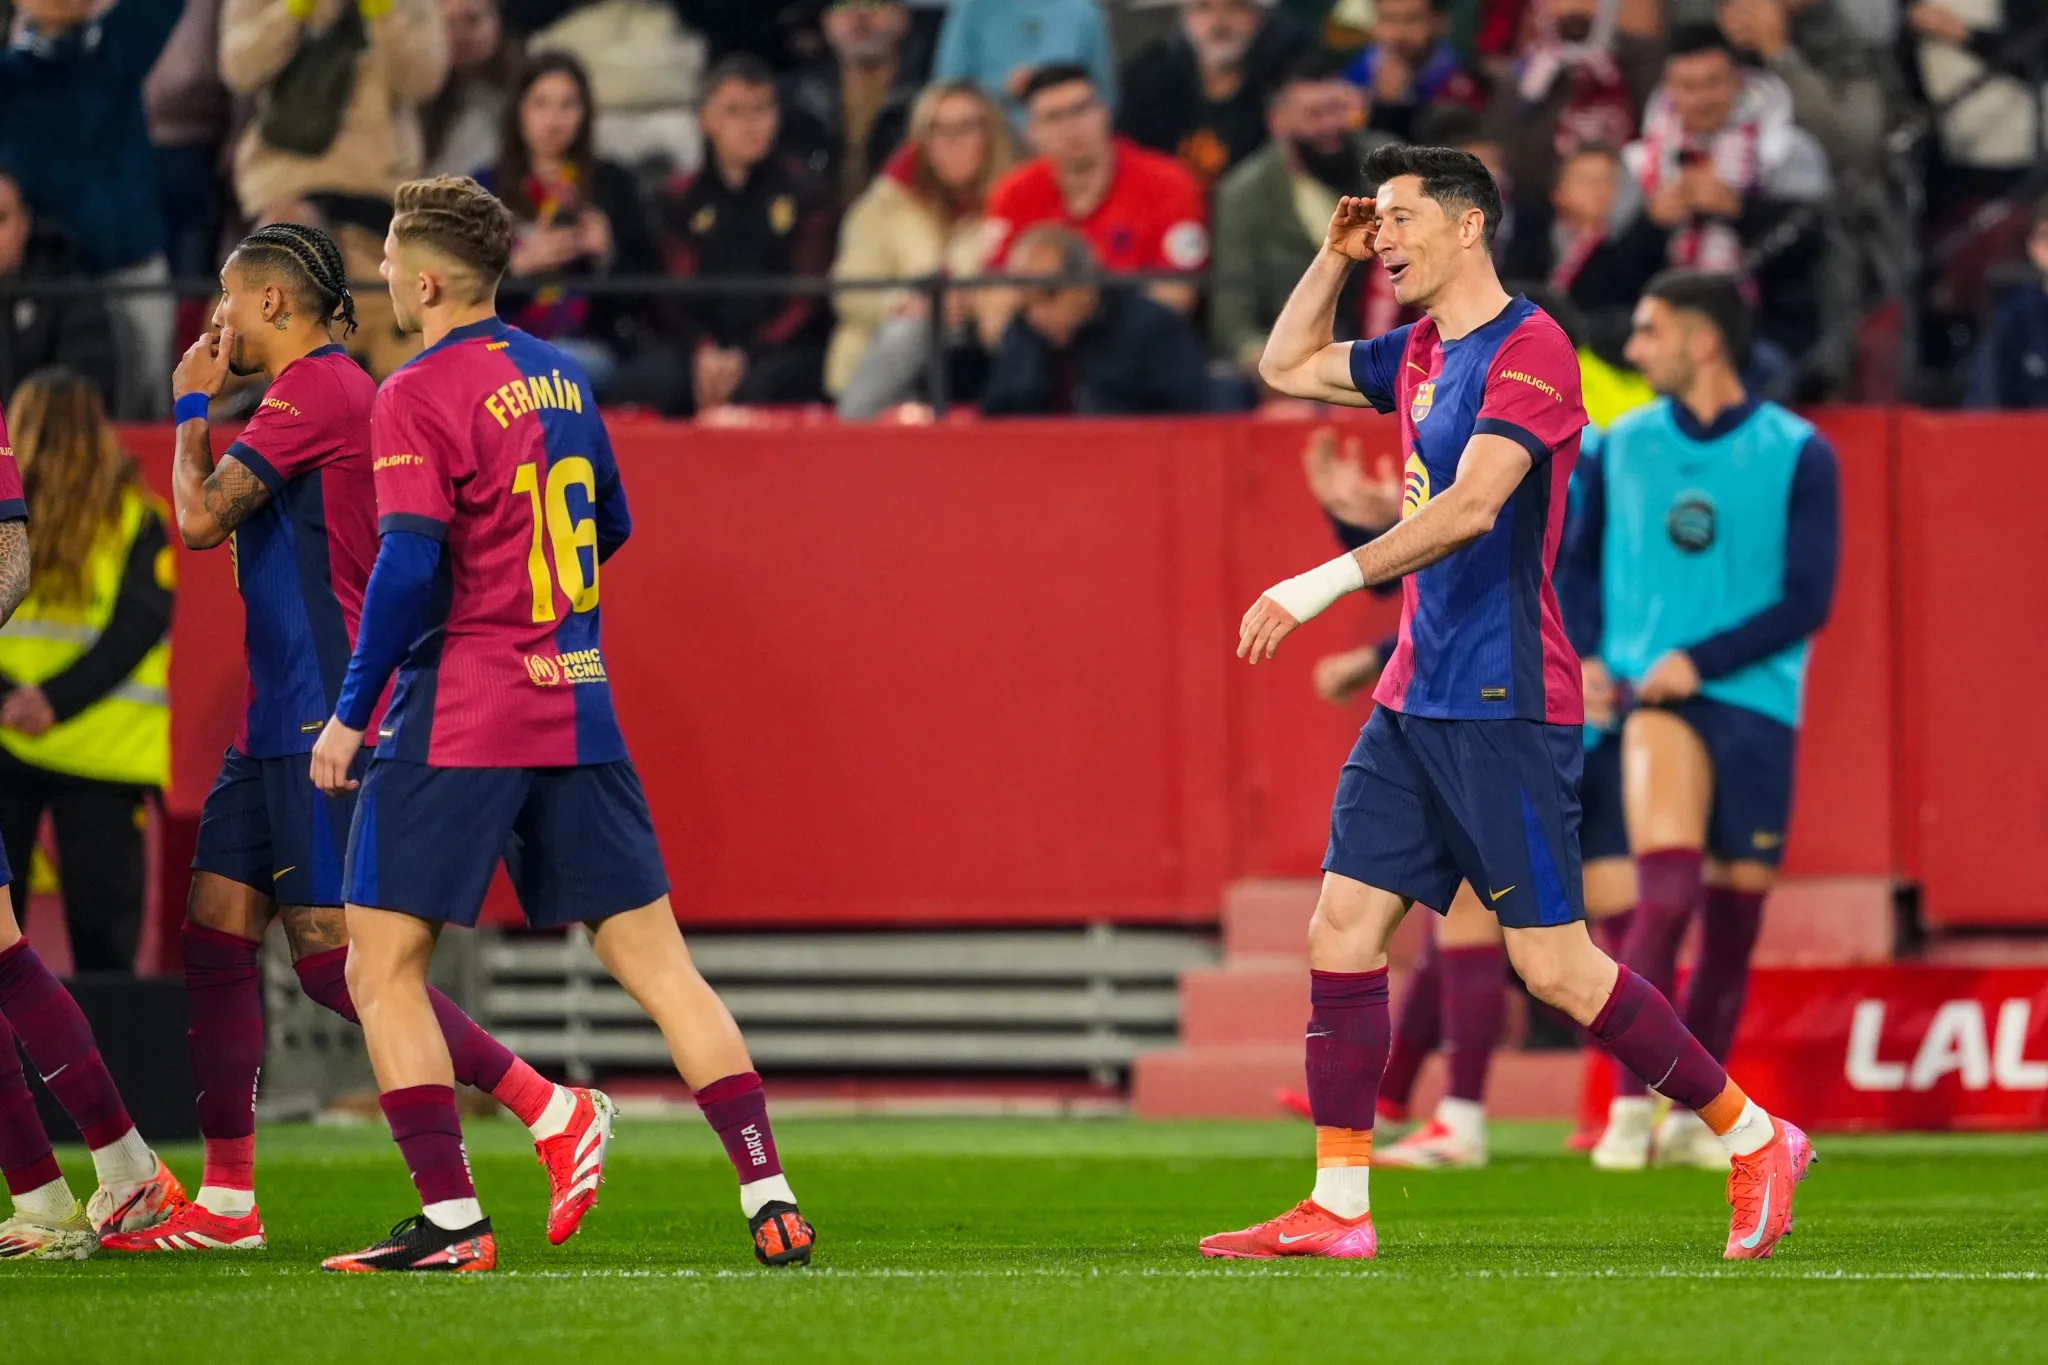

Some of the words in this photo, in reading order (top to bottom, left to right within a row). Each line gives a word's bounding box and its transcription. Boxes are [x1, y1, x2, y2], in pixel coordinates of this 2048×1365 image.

[484, 368, 582, 429] FERMÍN
[1500, 370, 1555, 396] AMBILIGHT
[289, 406, 301, 417] tv
[511, 456, 600, 623] 16
[564, 662, 606, 679] ACNU
[1844, 998, 2048, 1091] LAL
[741, 1123, 767, 1166] BARÇA
